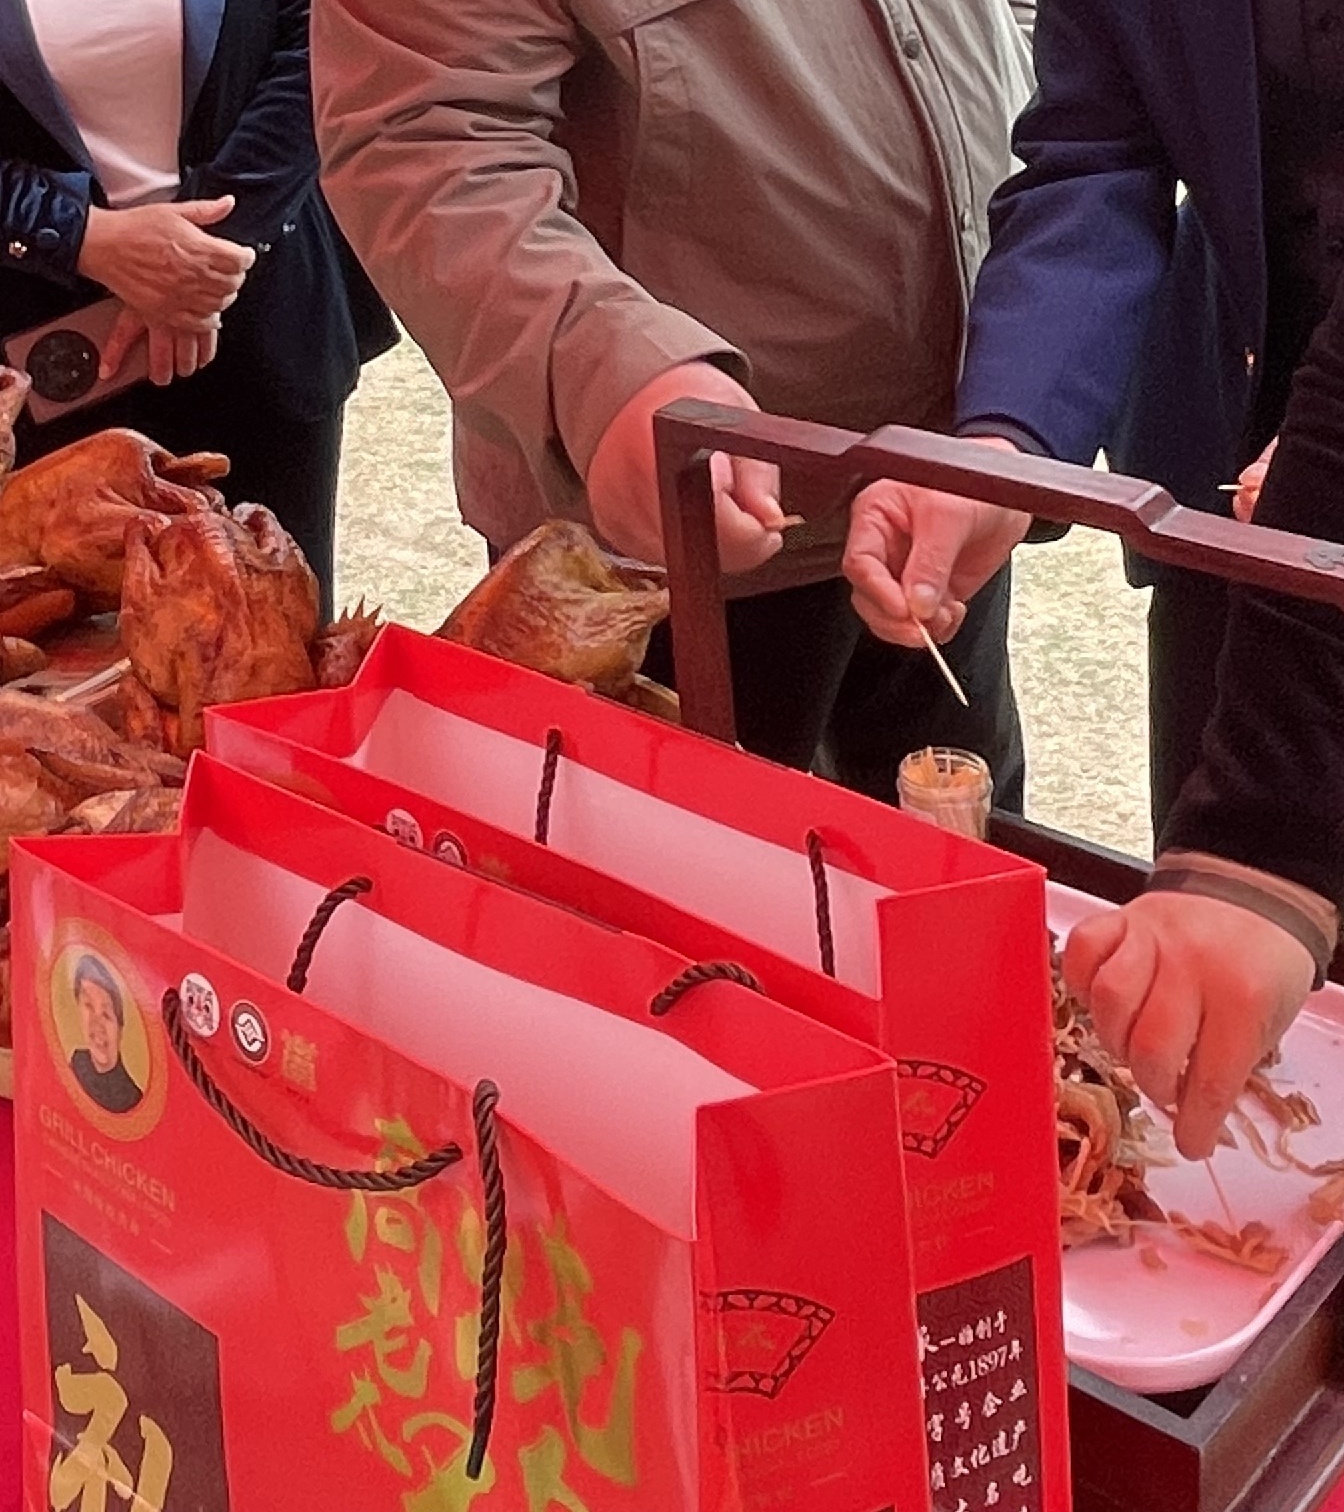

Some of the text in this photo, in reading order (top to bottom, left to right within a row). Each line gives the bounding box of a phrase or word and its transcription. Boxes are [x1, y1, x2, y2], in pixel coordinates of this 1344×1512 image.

[91, 1142, 175, 1212] CHICKEN
[920, 1338, 1024, 1399] 公元1897年
